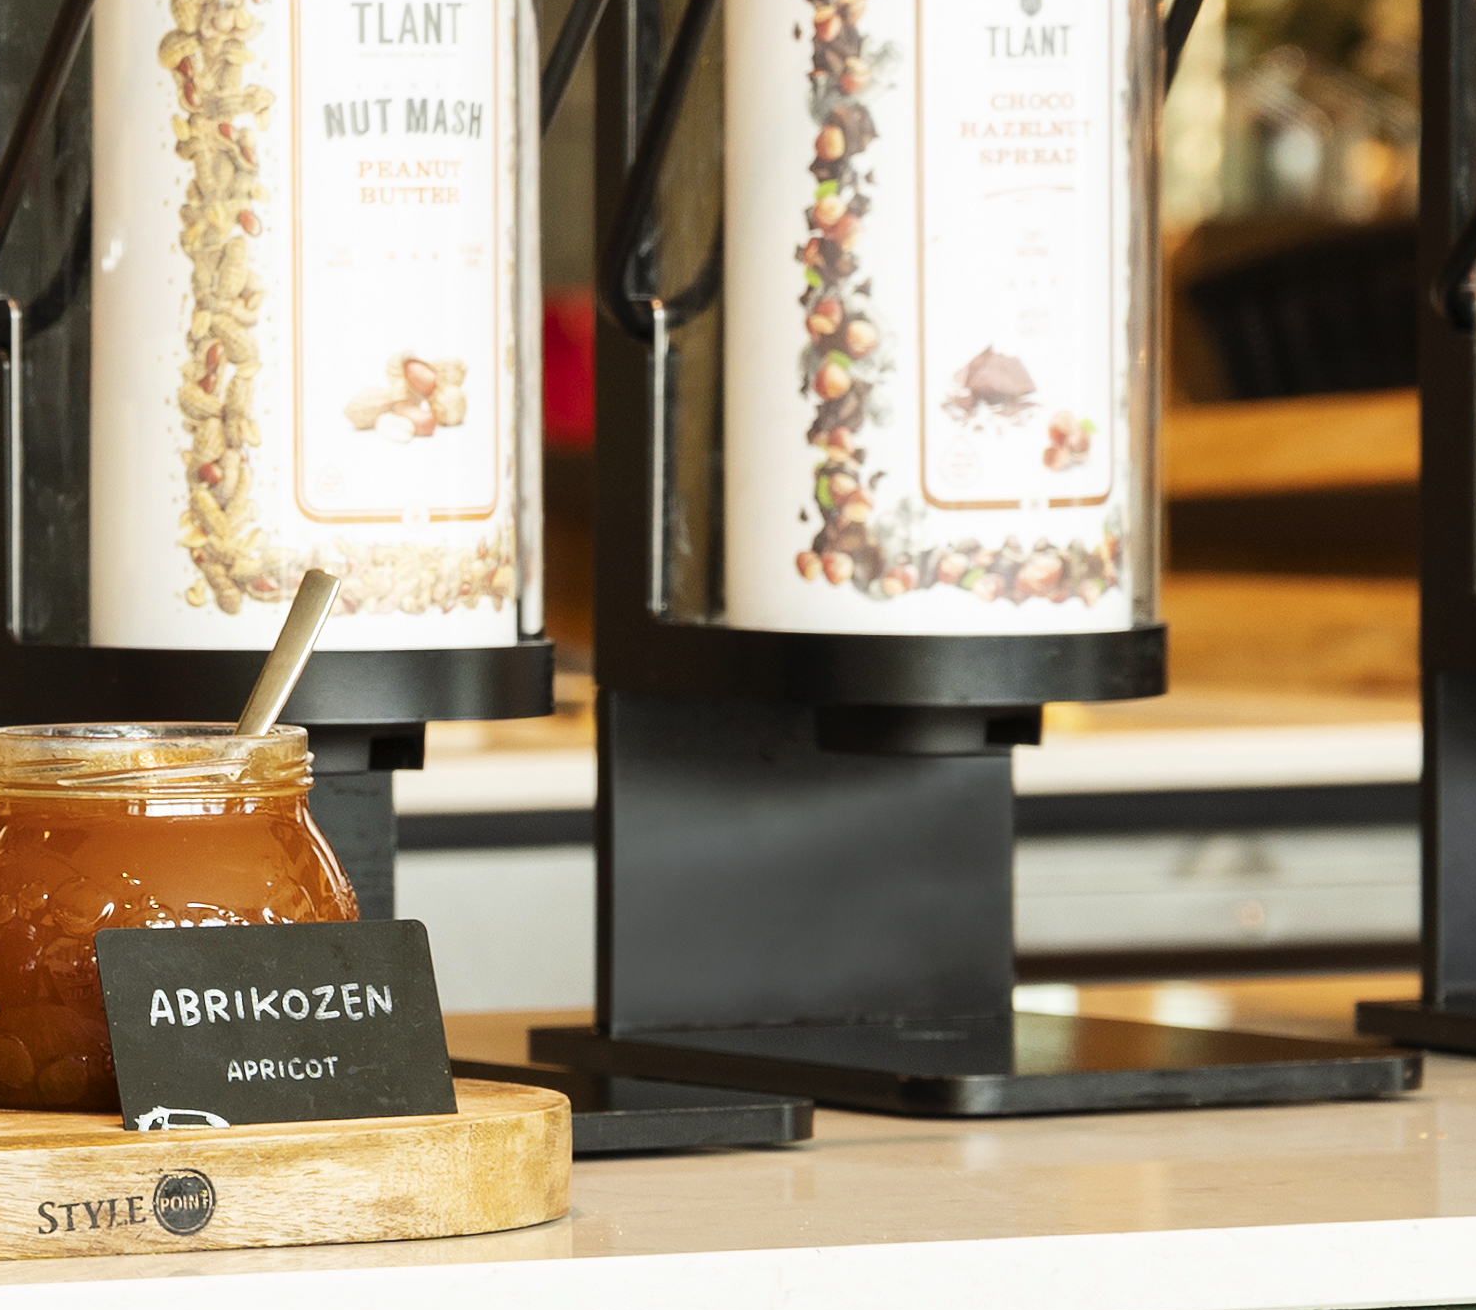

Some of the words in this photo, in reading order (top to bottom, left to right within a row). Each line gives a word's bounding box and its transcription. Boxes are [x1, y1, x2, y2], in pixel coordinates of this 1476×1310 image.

[351, 1, 462, 45] TLANT
[986, 25, 1072, 58] TLANT
[990, 93, 1075, 110] CHOCO
[323, 98, 393, 140] NUT
[405, 98, 483, 140] MASH
[357, 160, 462, 179] PEANUT
[979, 148, 1077, 165] SPREAD
[359, 187, 461, 205] BUTTER
[150, 983, 393, 1027] ABRIKOZEN
[227, 1057, 339, 1083] APRICOT
[37, 1195, 147, 1235] STYLE
[160, 1193, 209, 1212] POINT
